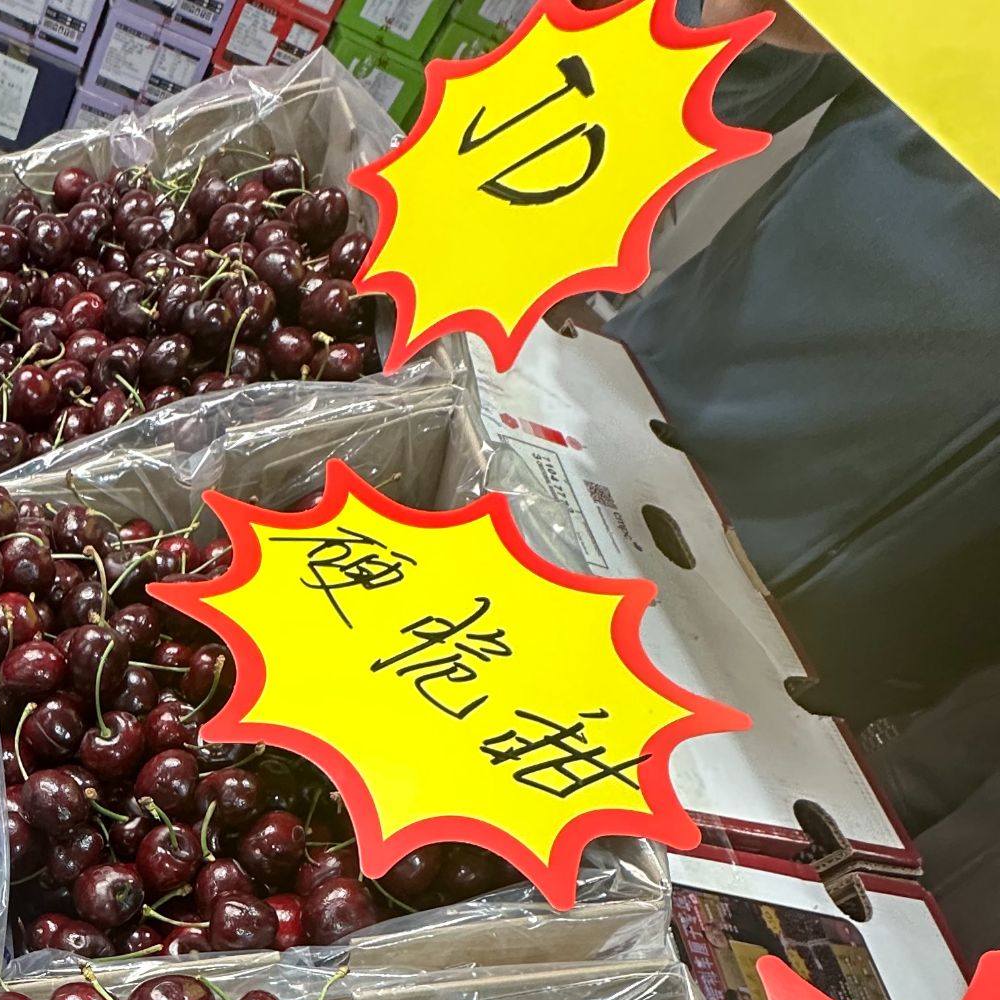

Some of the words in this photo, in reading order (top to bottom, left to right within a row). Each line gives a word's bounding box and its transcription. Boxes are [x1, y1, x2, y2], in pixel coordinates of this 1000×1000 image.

[458, 55, 606, 205] JD
[269, 526, 652, 798] 硬脆甜
